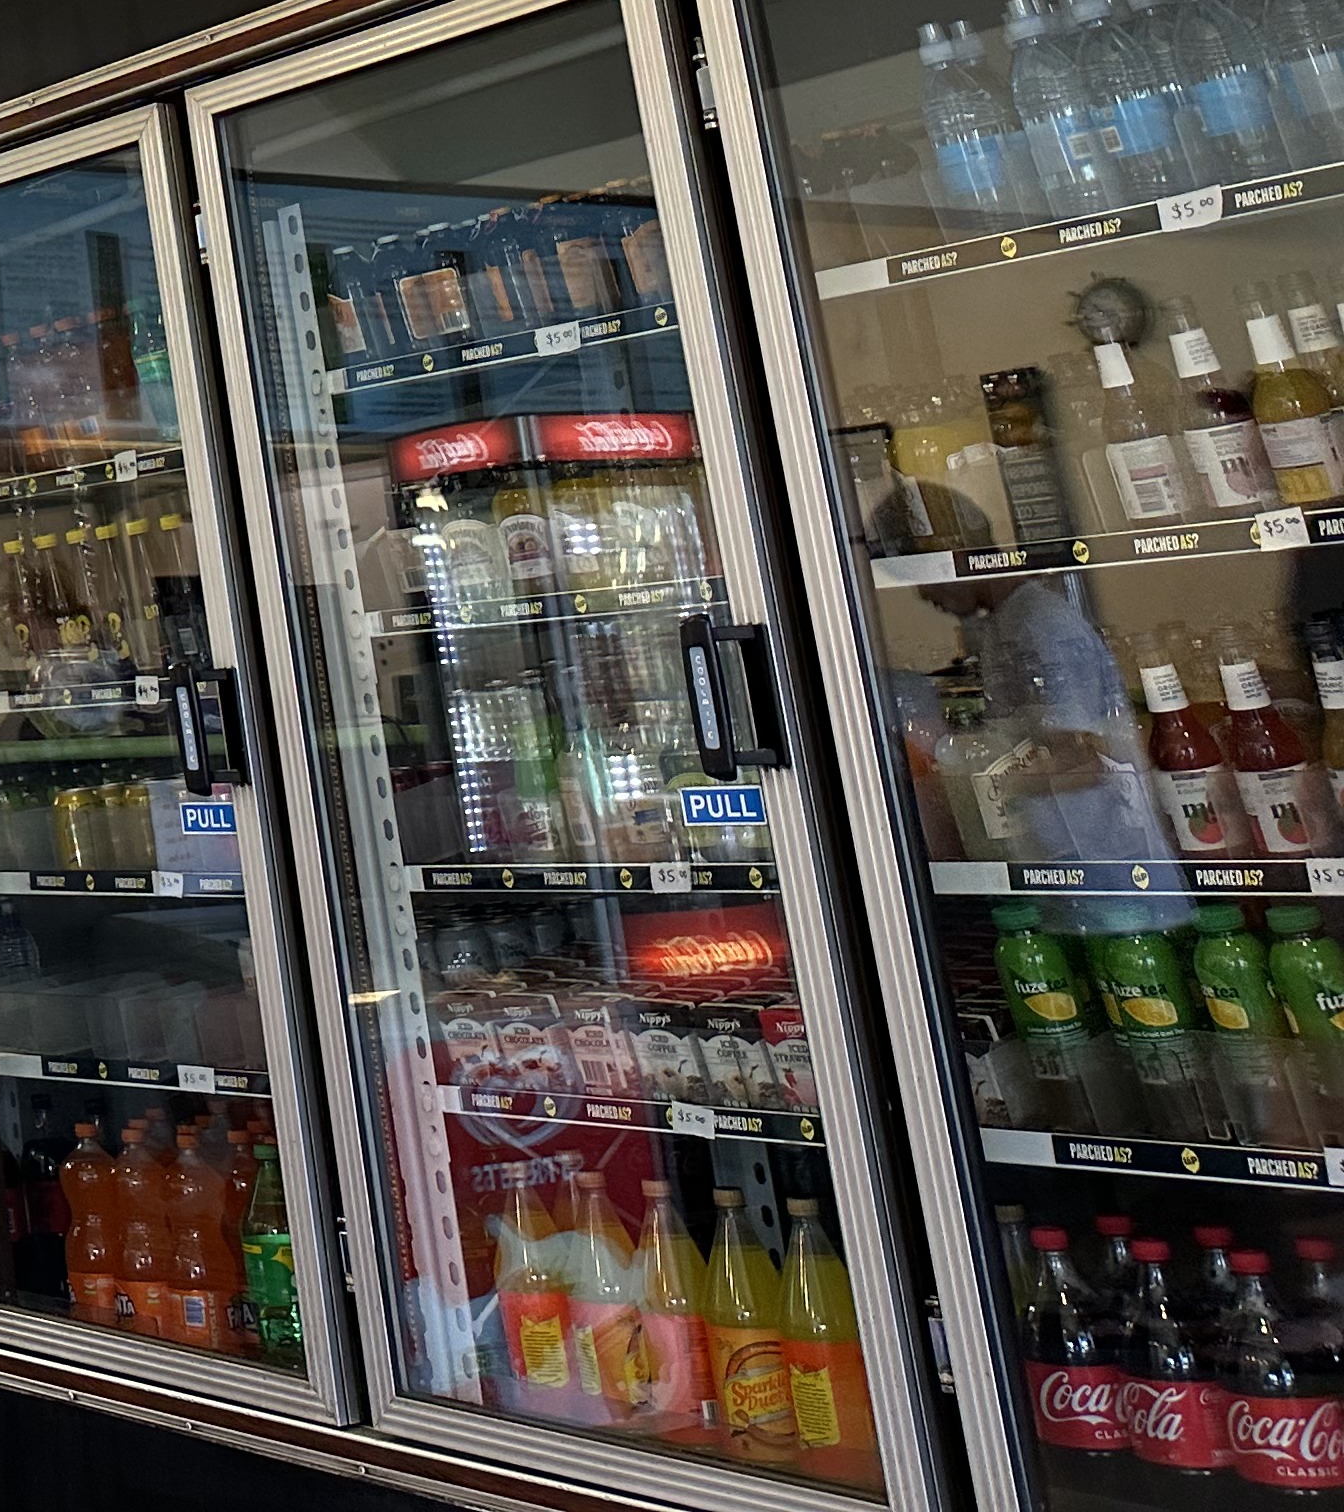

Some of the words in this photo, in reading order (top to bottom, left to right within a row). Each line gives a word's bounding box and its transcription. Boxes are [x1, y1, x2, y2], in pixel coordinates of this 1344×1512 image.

[689, 794, 757, 818] PULL
[187, 808, 232, 830] PULL
[1277, 1466, 1339, 1477] CLASSIC
